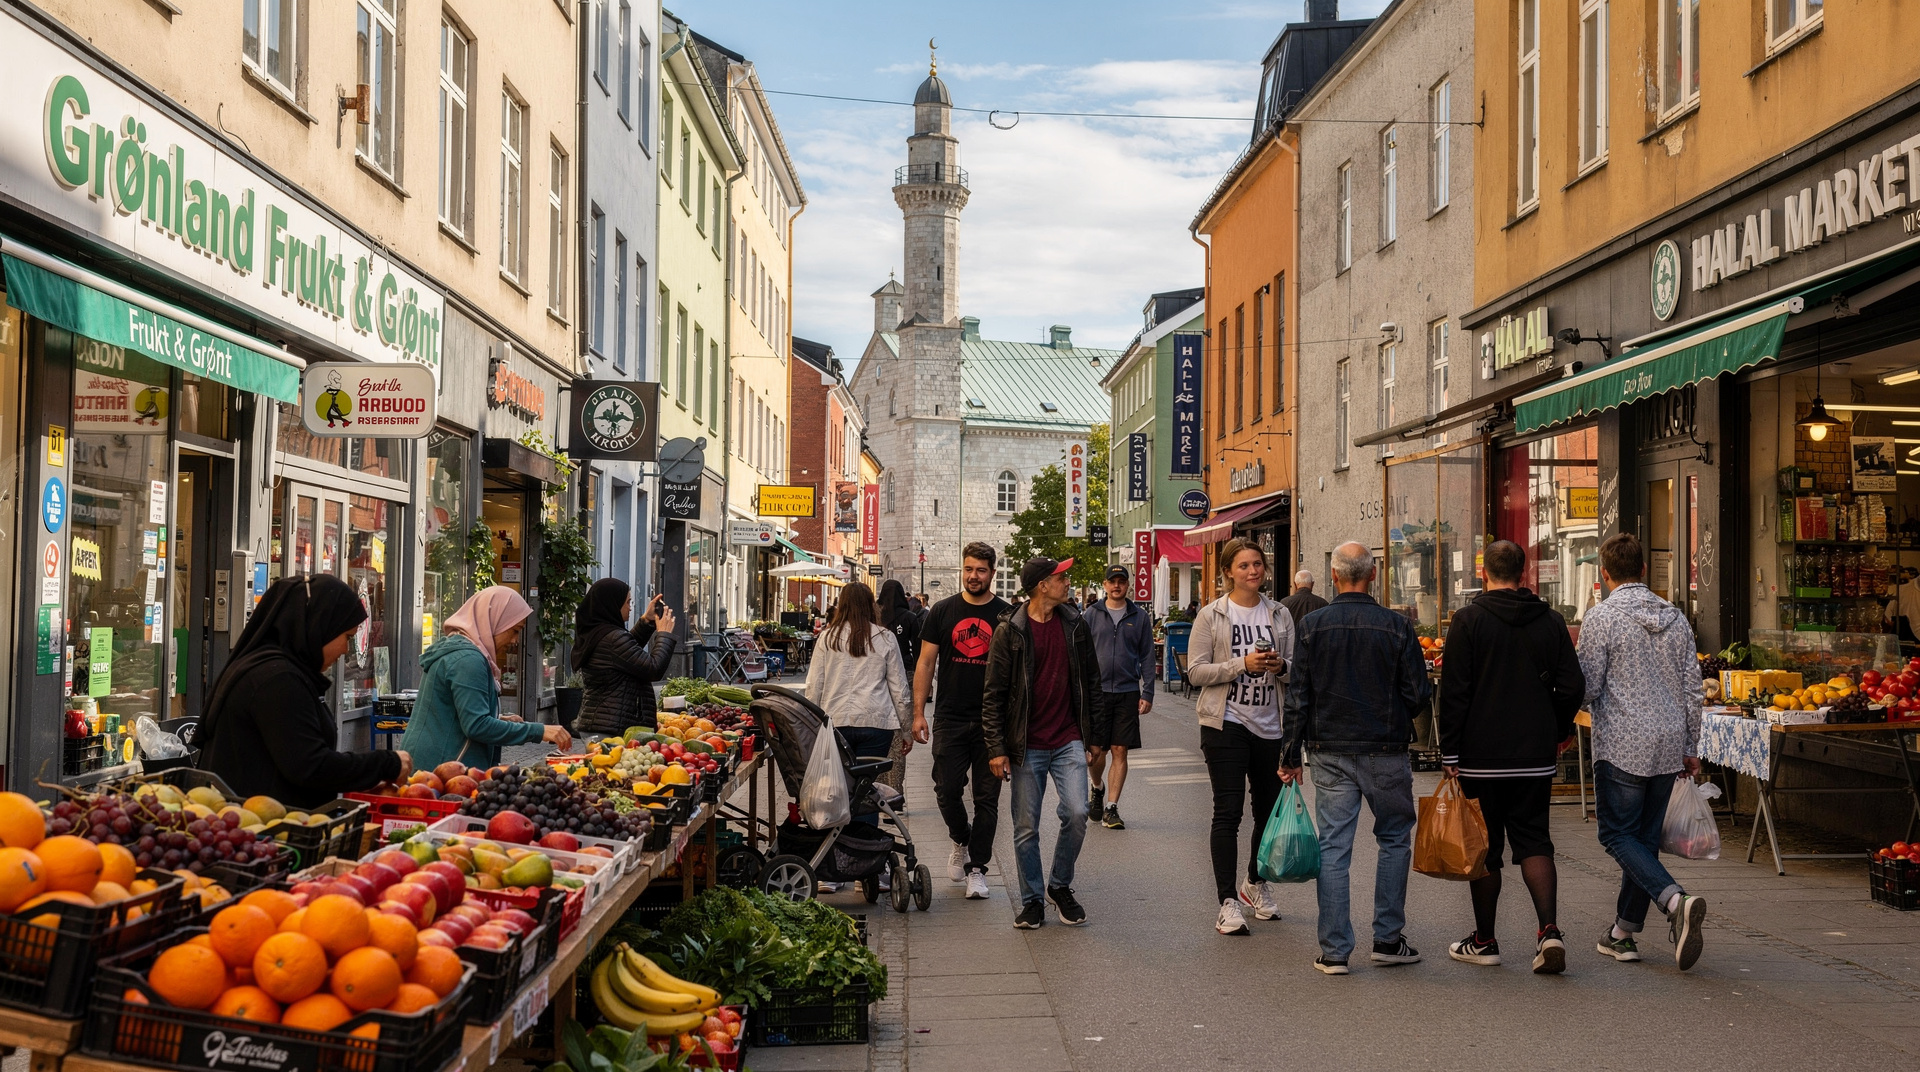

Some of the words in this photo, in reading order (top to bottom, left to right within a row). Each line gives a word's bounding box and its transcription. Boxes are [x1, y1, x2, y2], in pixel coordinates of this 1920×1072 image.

[1692, 208, 1780, 292] HALAL
[1785, 133, 1920, 253] MARKET
[264, 204, 346, 322] Frukt
[350, 256, 373, 337] &
[129, 307, 171, 357] Frukt
[174, 327, 186, 363] &
[1494, 306, 1554, 371] HALAL
[358, 397, 426, 413] ARBUOD
